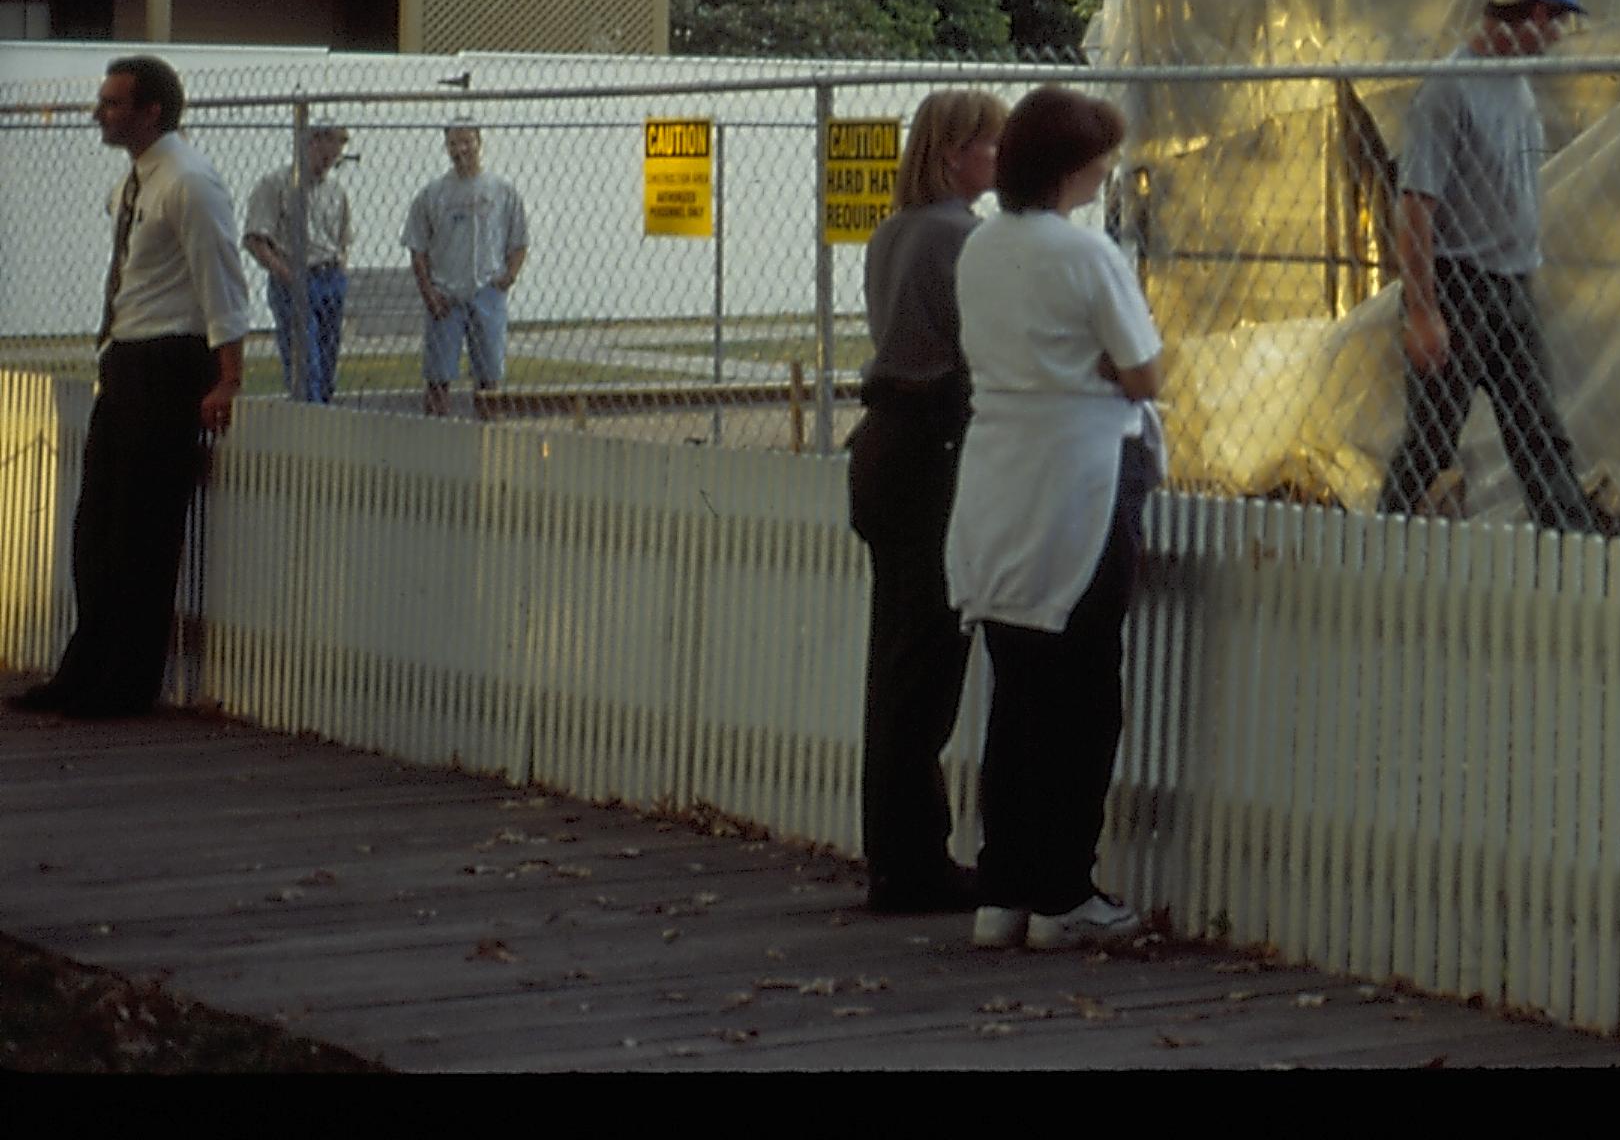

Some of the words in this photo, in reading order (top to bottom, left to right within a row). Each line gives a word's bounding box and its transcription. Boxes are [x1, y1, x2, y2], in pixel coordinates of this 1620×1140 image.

[648, 125, 706, 154] CAUTION
[831, 126, 894, 157] CAUTION
[827, 169, 864, 193] HARD
[870, 169, 897, 193] HAT
[827, 203, 892, 230] REQUIRE
